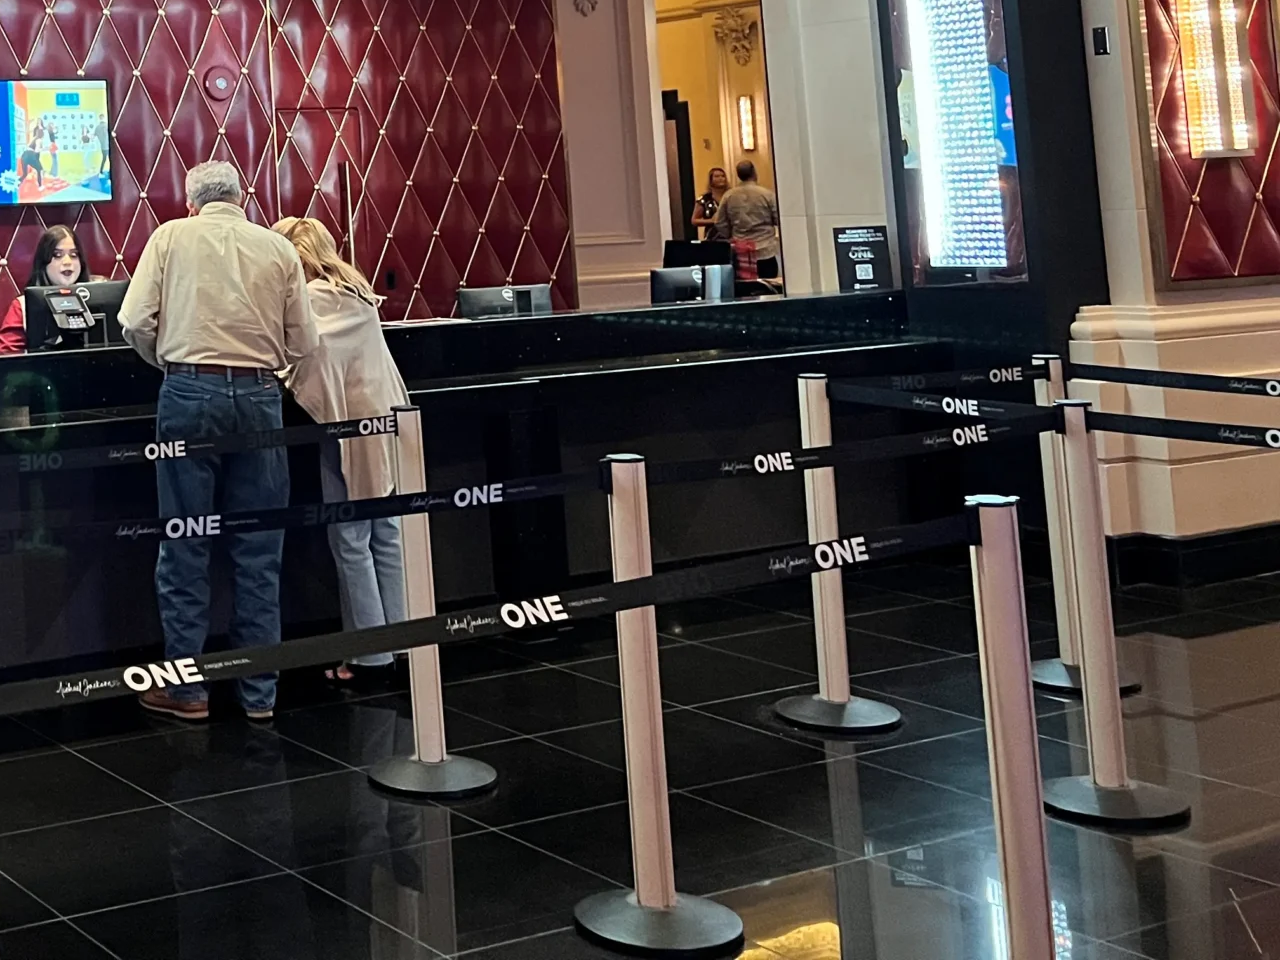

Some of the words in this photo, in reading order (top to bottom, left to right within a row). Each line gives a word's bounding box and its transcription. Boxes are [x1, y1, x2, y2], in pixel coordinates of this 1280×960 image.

[989, 367, 1024, 383] ONE
[942, 396, 980, 417] ONE
[359, 416, 397, 436] ONE
[952, 424, 989, 446] ONE
[144, 440, 187, 460] ONE
[754, 451, 795, 474] ONE
[454, 483, 503, 508] ONE
[165, 515, 222, 539] ONE
[814, 536, 869, 569] ONE
[500, 595, 569, 629] ONE
[123, 658, 204, 692] ONE
